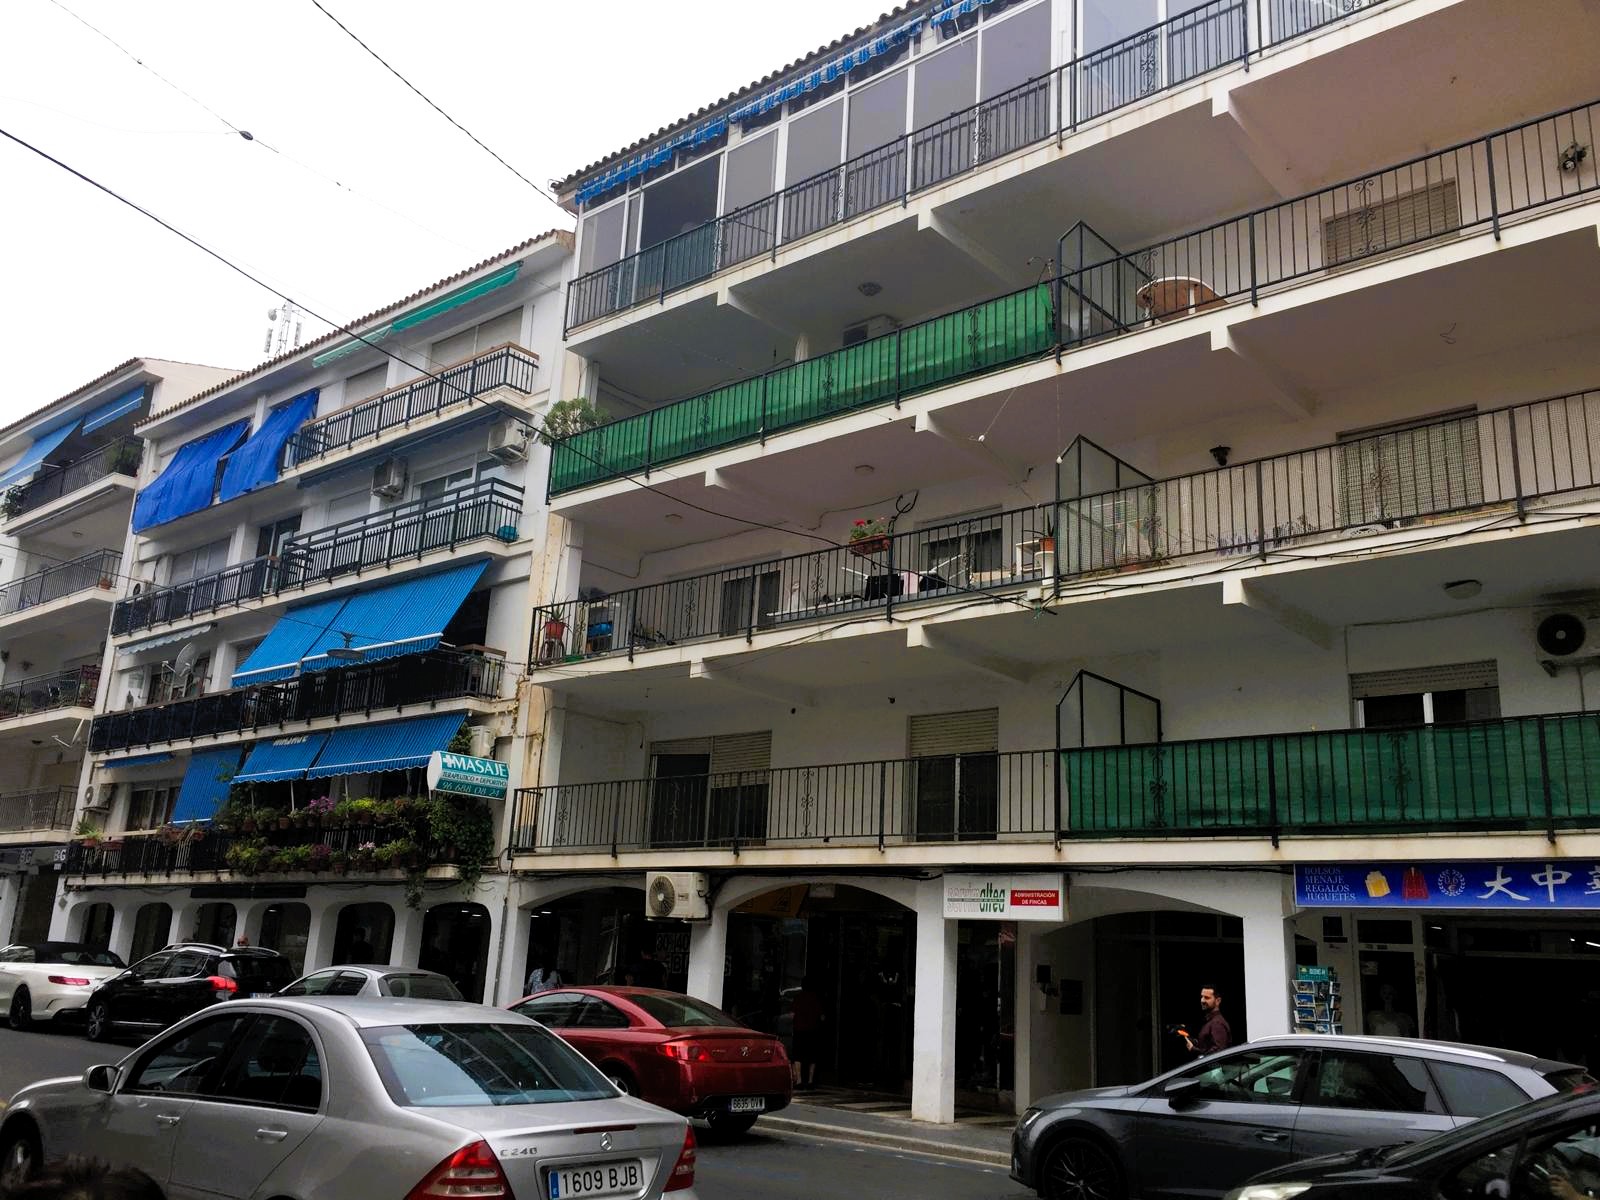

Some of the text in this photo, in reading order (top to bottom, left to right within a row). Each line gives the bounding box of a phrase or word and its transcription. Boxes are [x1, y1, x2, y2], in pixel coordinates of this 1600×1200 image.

[453, 756, 508, 777] MASAJE
[1304, 866, 1341, 875] BOLSOS
[1305, 875, 1345, 884] MENAJE
[1305, 884, 1350, 893] REGALOS
[1304, 892, 1357, 901] JUGUETES
[562, 1166, 638, 1194] 1609 BJB
